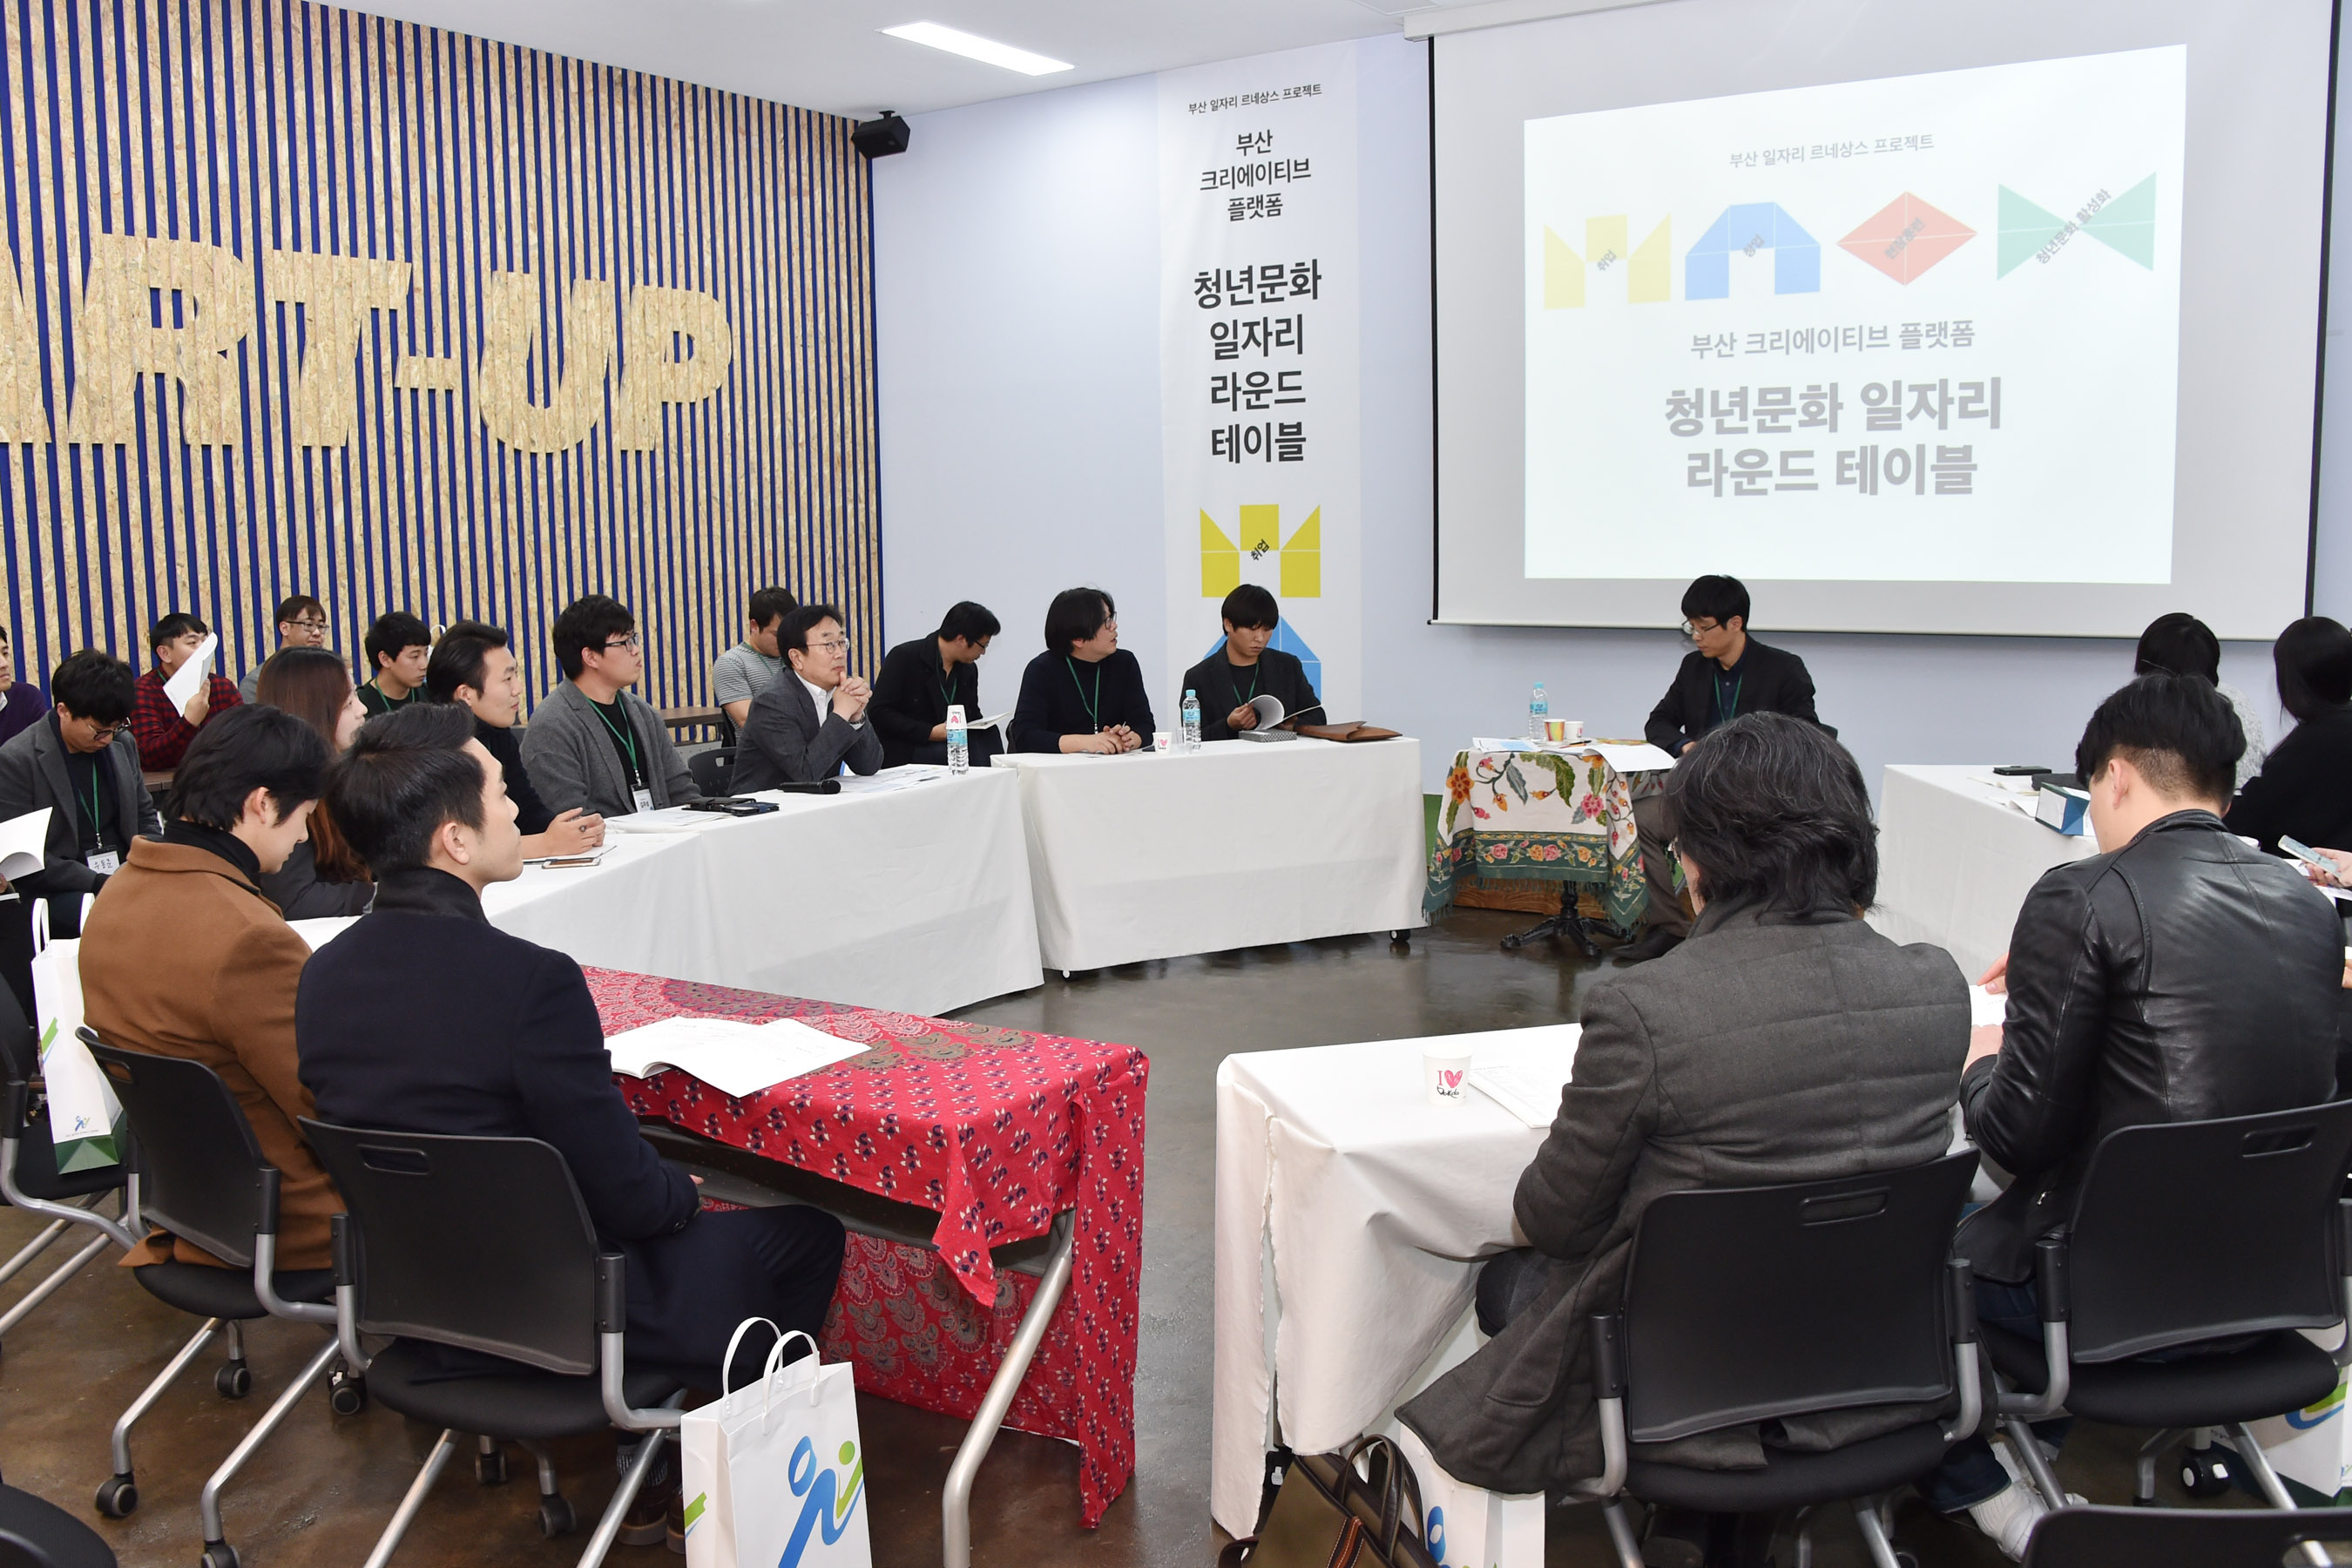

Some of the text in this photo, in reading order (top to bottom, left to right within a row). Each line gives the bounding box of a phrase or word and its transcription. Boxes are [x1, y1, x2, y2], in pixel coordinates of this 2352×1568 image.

[1188, 84, 1322, 115] 부산 일자리 르네상스 프로젝트
[1236, 129, 1273, 156] 부산
[1729, 134, 1935, 168] 부산 일자리 르네상스 프로젝트
[1200, 158, 1312, 191] 크리에이티브
[1227, 193, 1283, 221] 플랫폼
[2036, 187, 2112, 265] 청년문화 활성화
[1597, 248, 1617, 271] 취업
[1743, 233, 1765, 257] 창업
[1193, 259, 1322, 309] 청년문화
[1210, 314, 1303, 360] 일자리
[1691, 320, 1975, 359] 부산 크리에이티브 플랫폼
[1211, 370, 1306, 411] 라운드
[1665, 376, 2002, 437] 청년문화 일자리
[1212, 422, 1307, 463] 테이블
[1687, 443, 1978, 497] 라운드 테이블
[1250, 538, 1269, 561] 취업
[1436, 1070, 1443, 1085] I
